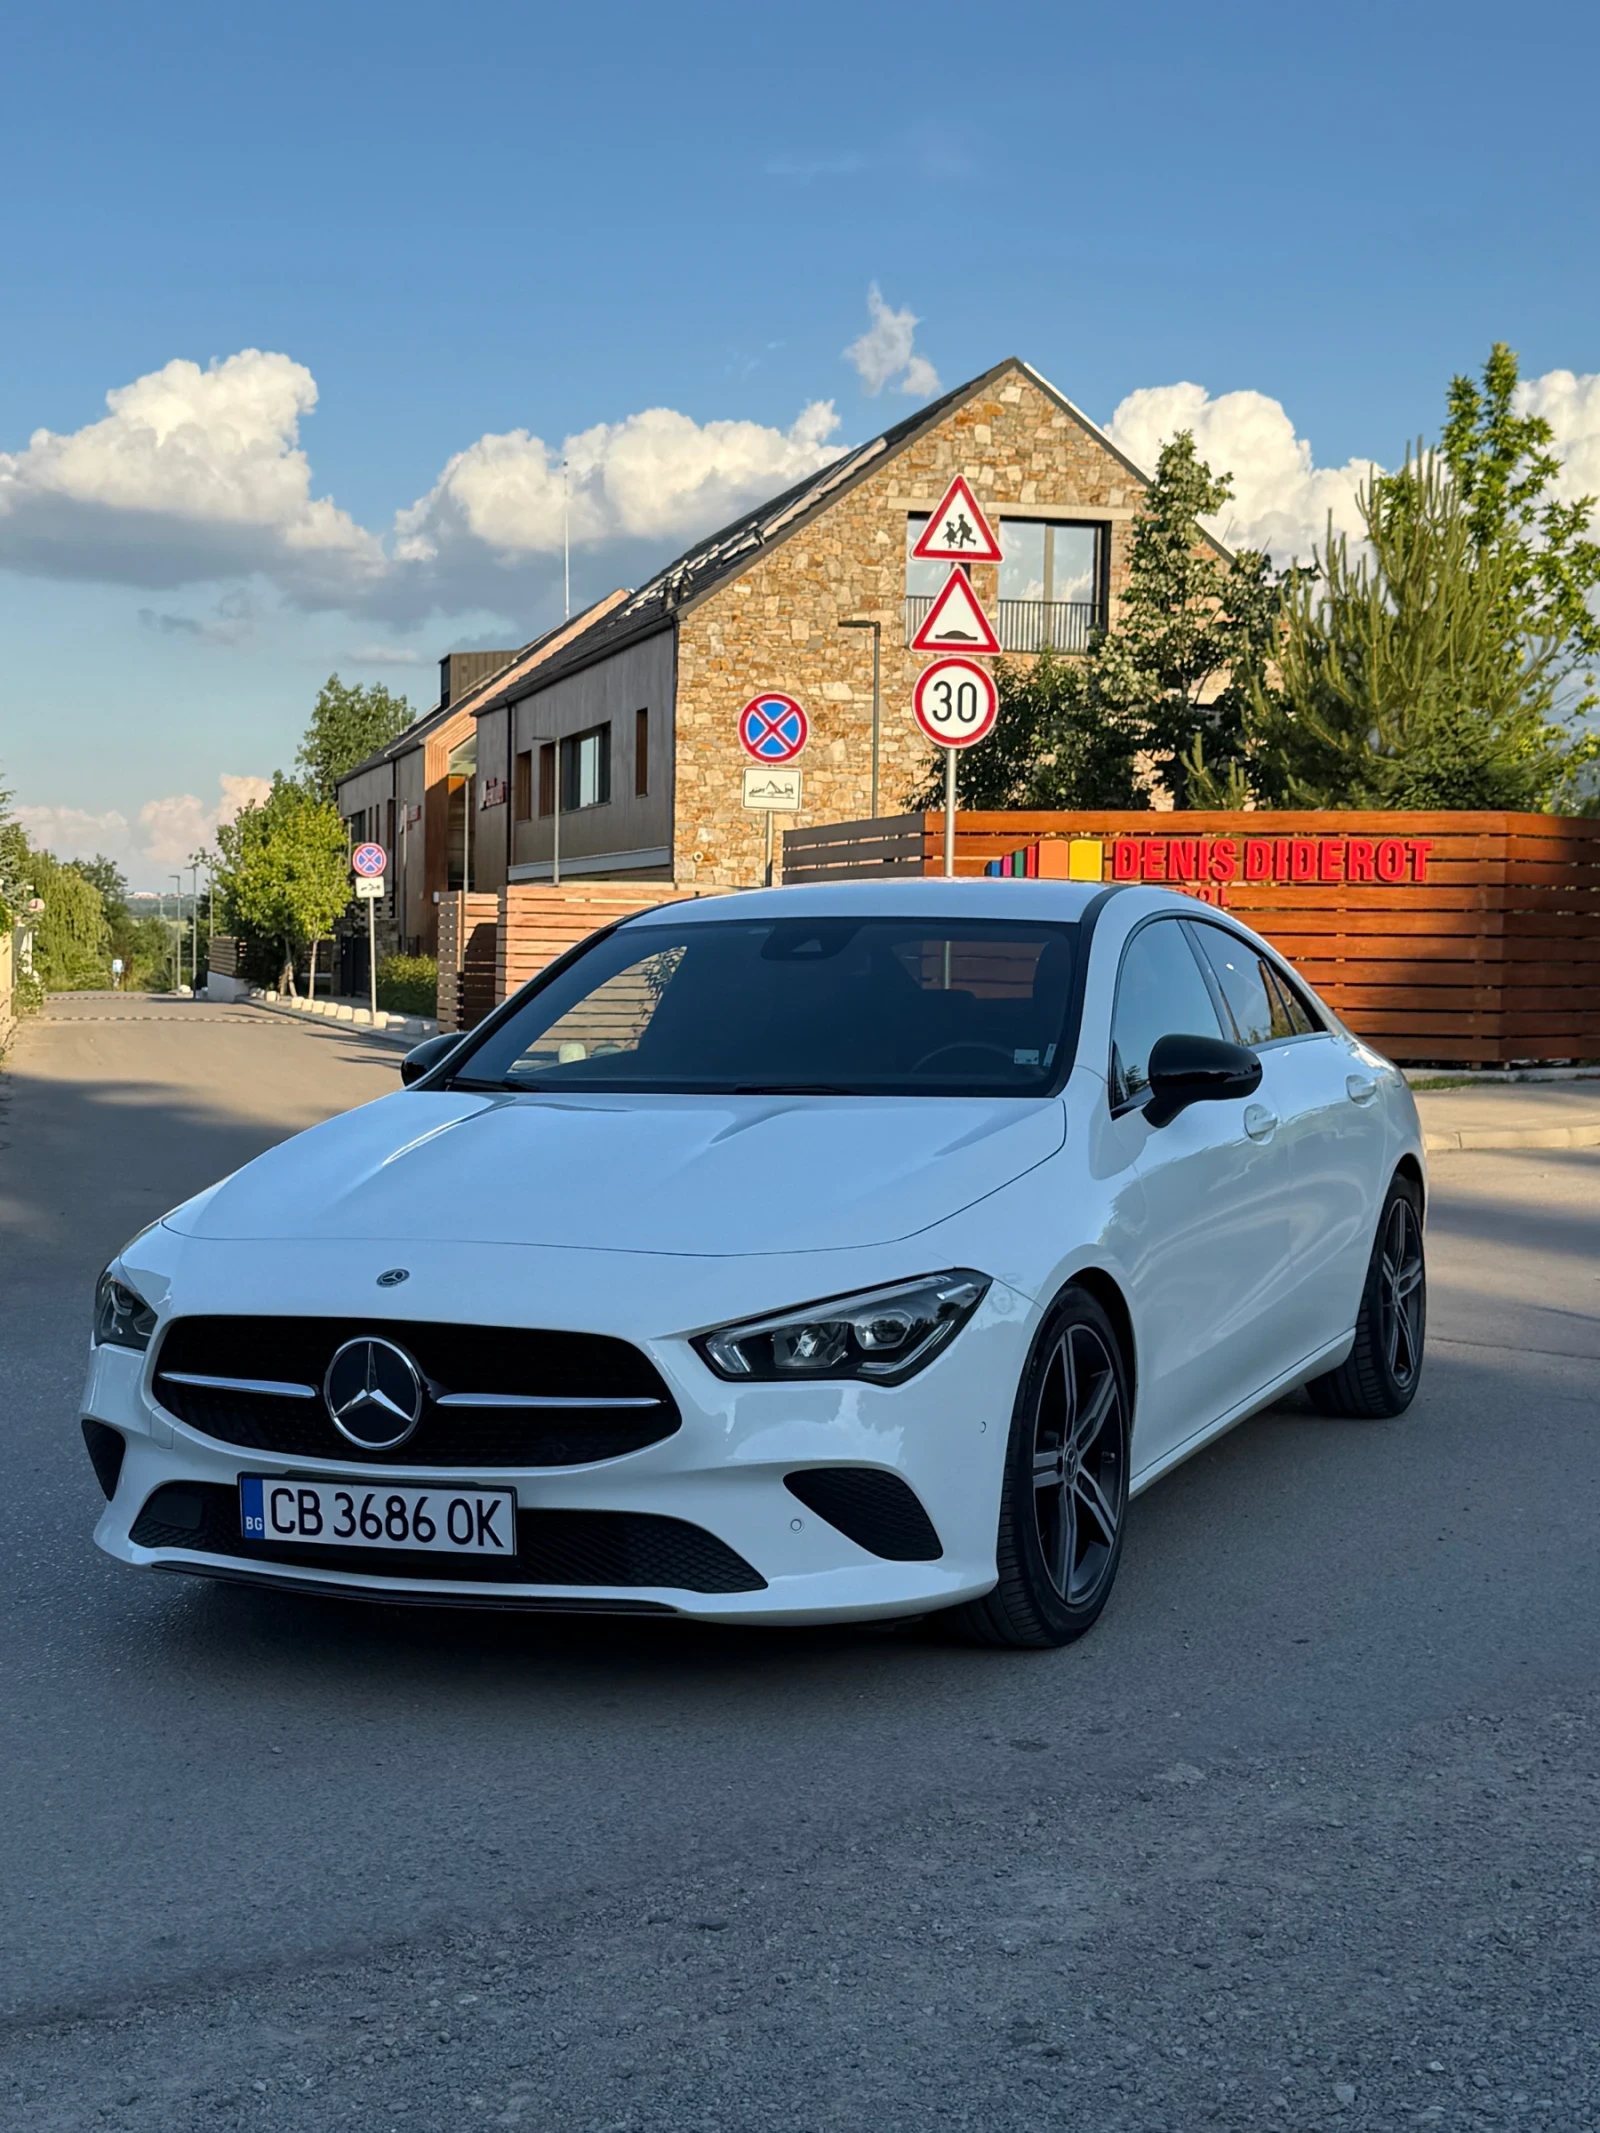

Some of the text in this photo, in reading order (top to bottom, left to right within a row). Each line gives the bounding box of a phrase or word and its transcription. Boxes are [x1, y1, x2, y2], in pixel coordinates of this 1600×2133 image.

[932, 680, 978, 723] 30
[1113, 839, 1434, 882] DENIS DIDEROT
[245, 1516, 263, 1531] BG
